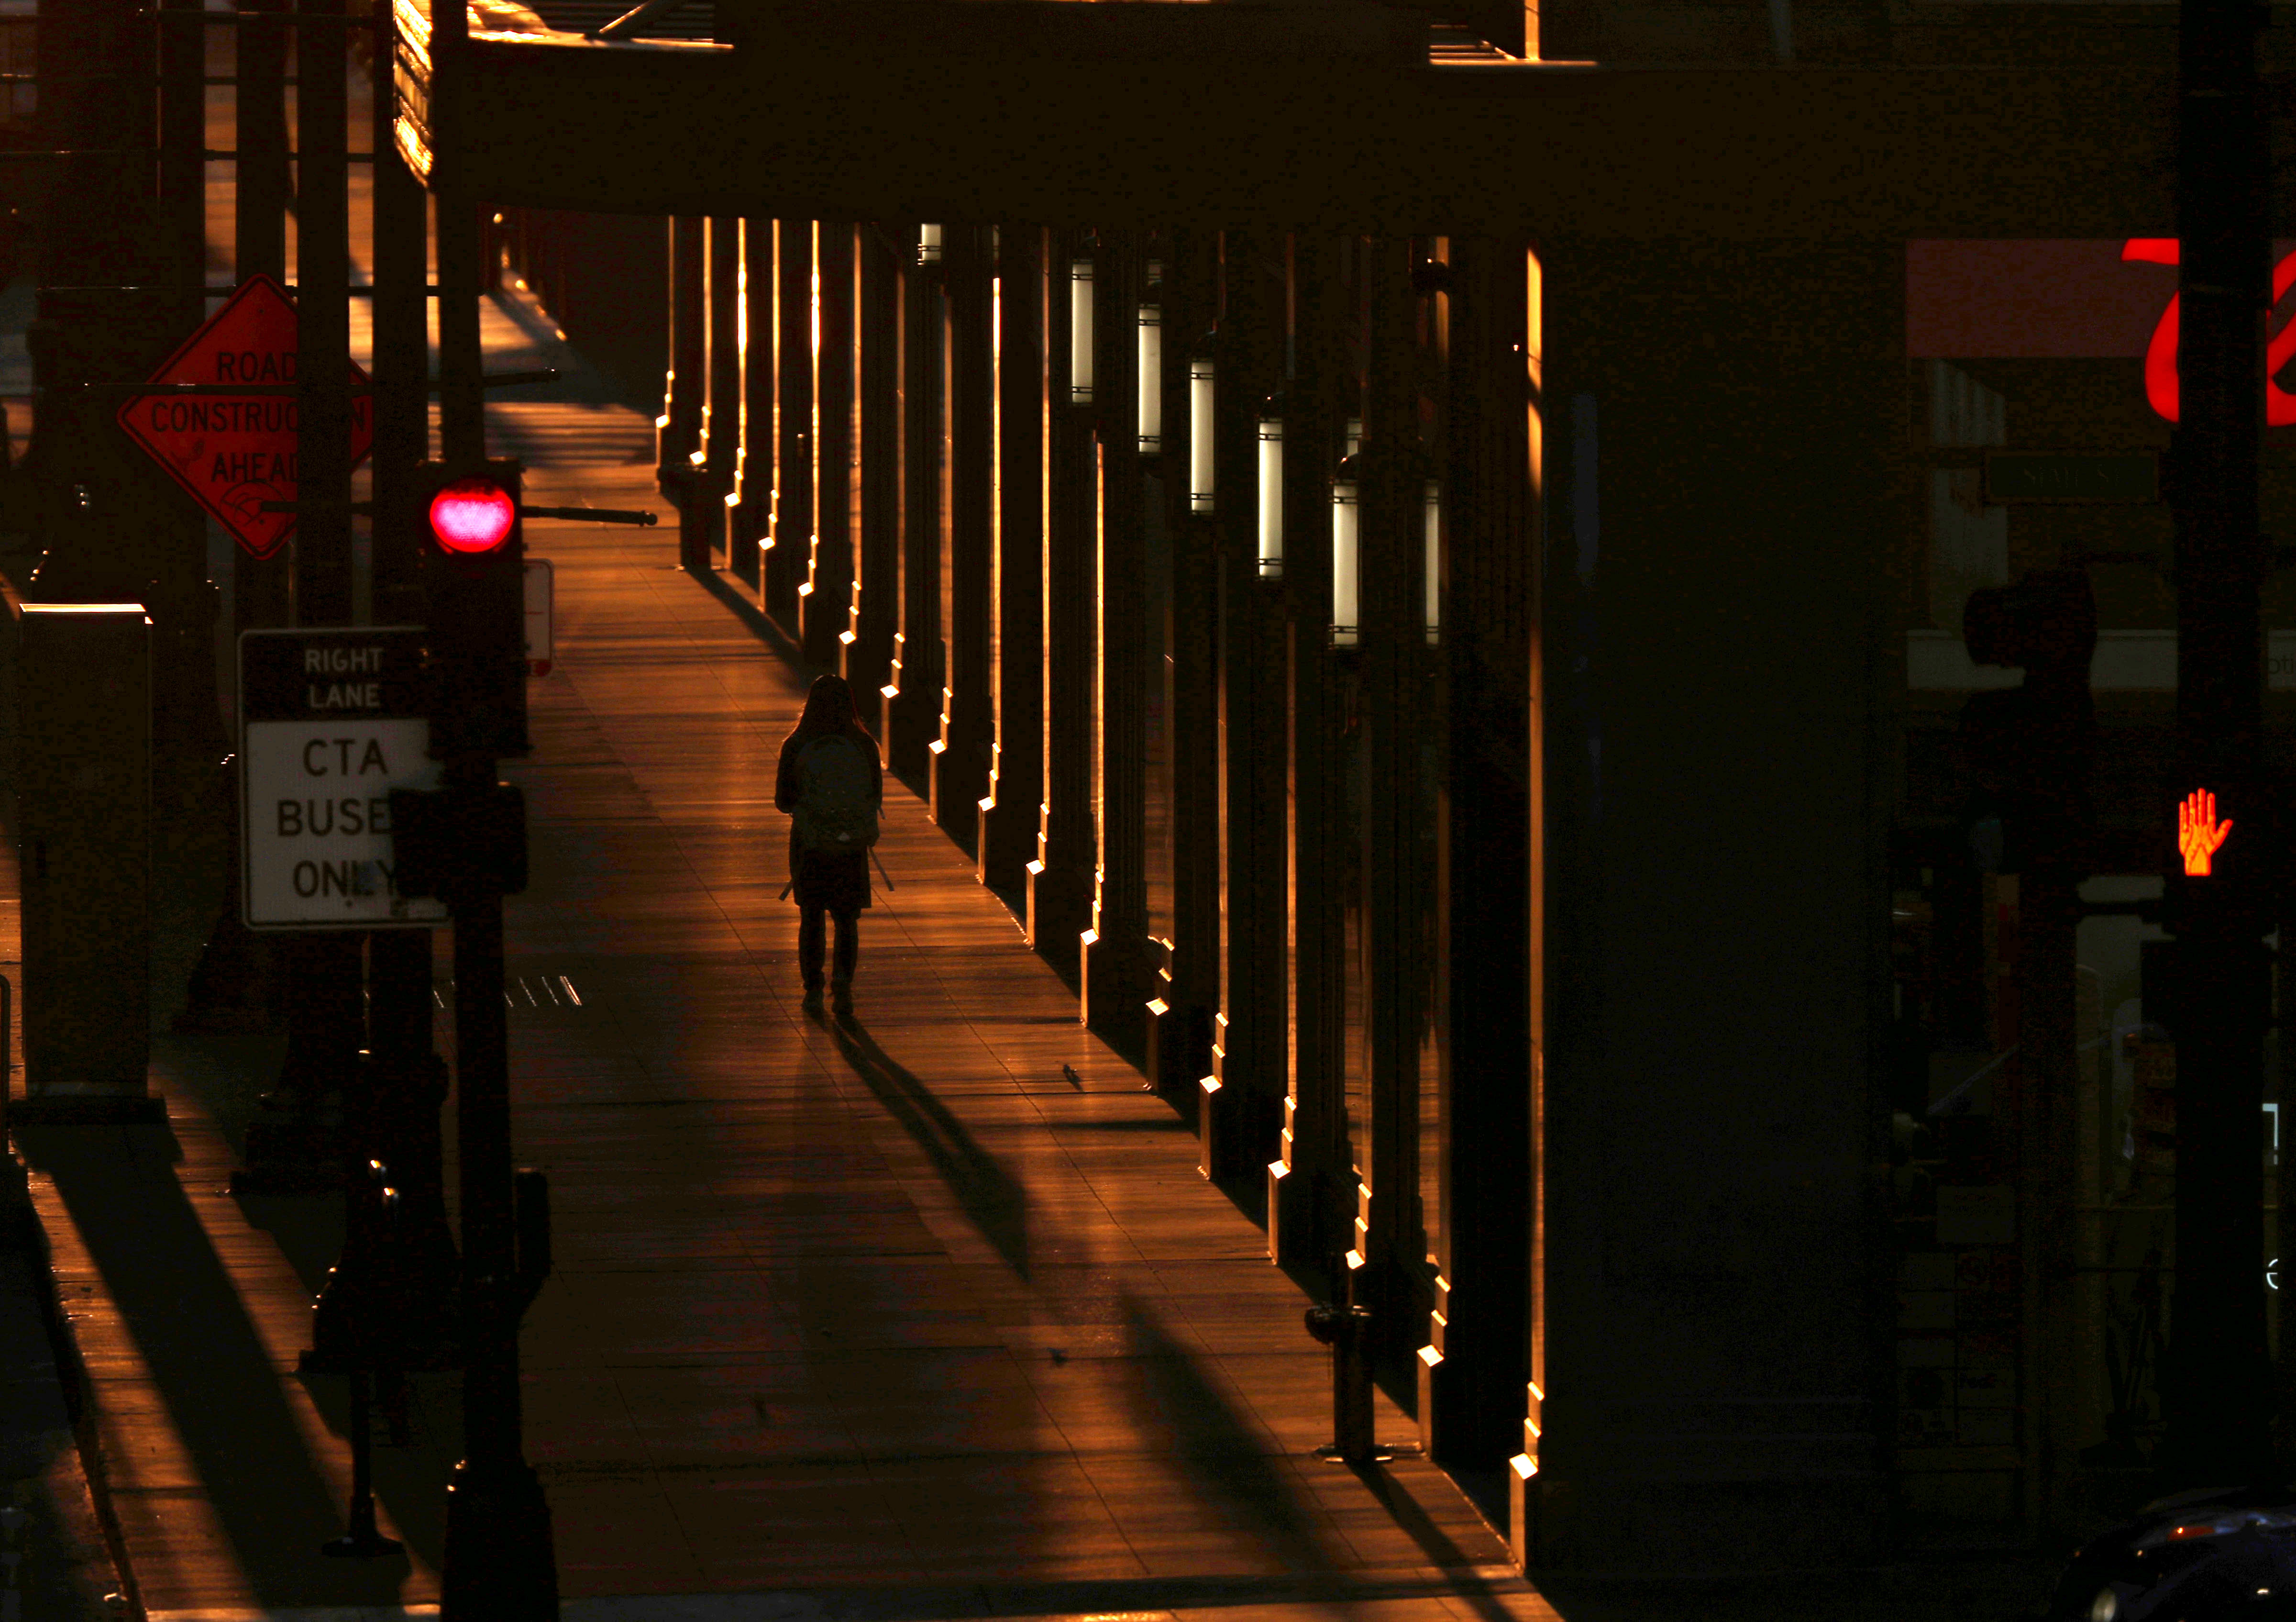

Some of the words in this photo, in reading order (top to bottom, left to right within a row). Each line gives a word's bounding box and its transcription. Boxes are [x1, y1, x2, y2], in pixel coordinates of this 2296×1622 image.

[217, 351, 297, 381] ROAD
[151, 402, 364, 432] CONSTRUCN
[304, 647, 384, 673] RIGHT
[309, 683, 380, 709] LANE
[303, 738, 387, 777] CTA
[277, 798, 391, 837] BUSE
[292, 860, 396, 898] ONLY
